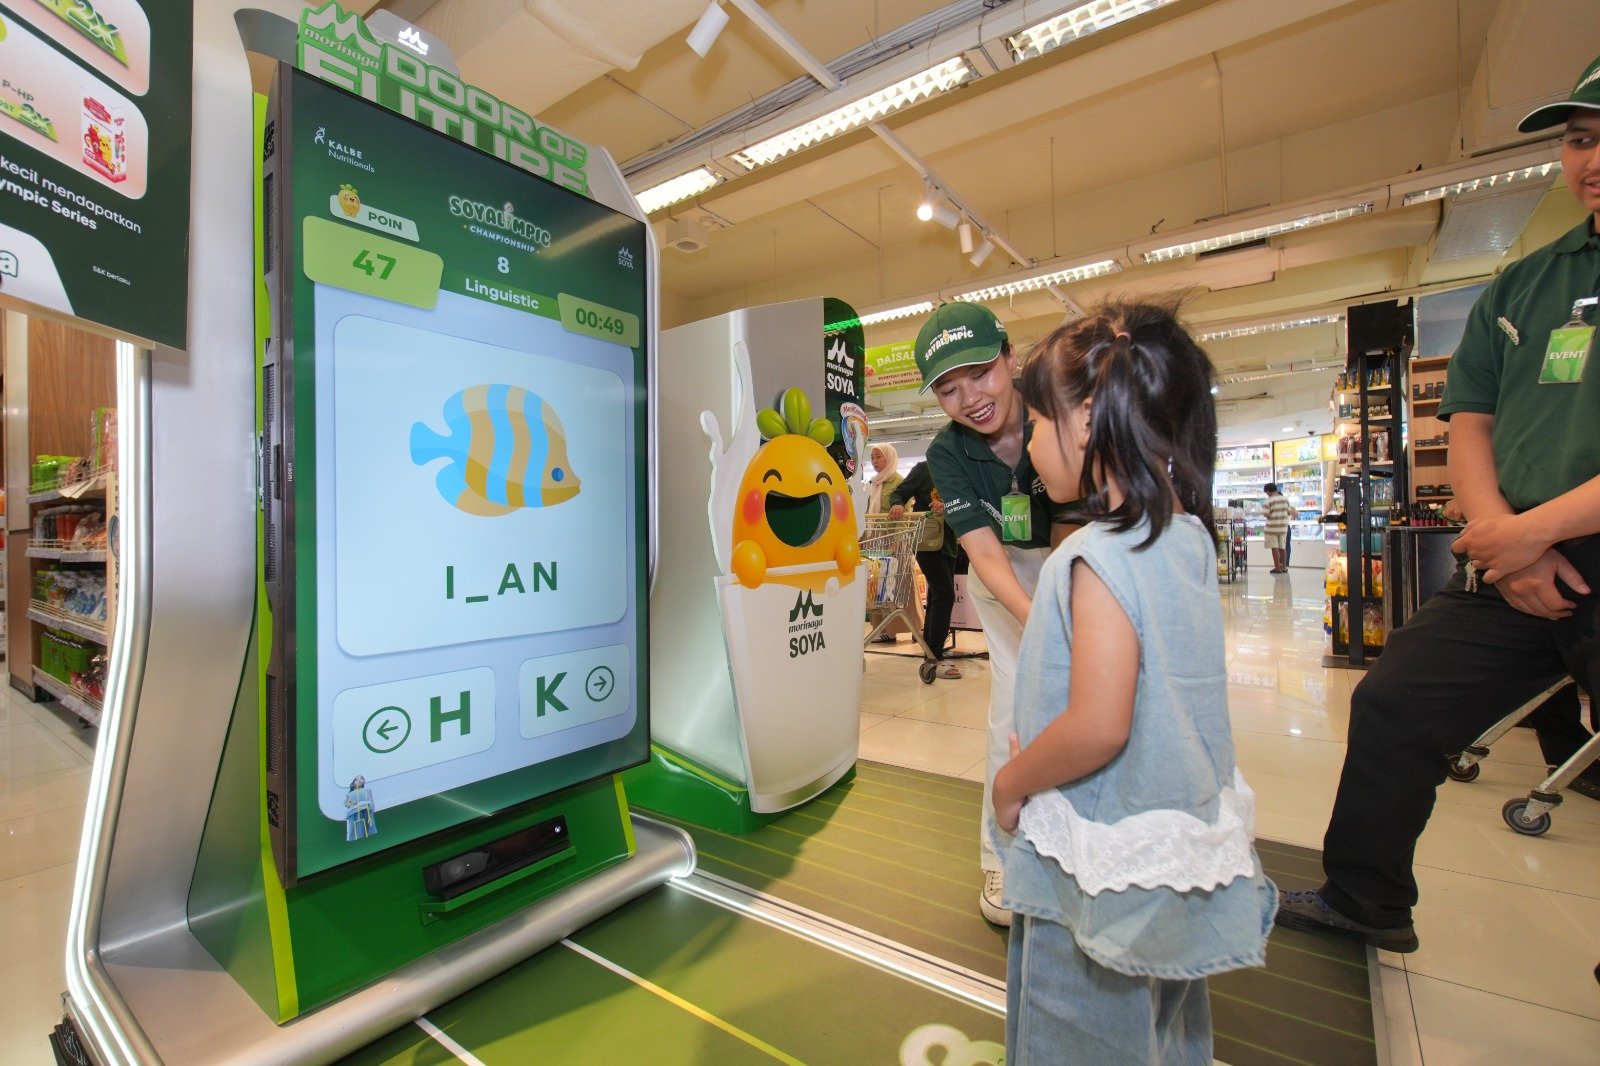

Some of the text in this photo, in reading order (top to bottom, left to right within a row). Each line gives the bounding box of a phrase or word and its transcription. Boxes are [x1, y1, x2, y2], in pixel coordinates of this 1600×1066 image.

[304, 28, 380, 70] morinaga
[387, 44, 587, 163] DOOR OF
[328, 139, 363, 159] KALBE
[328, 149, 375, 173] Nutritionals
[0, 156, 39, 184] kecil
[41, 177, 142, 234] mendapatkan
[51, 200, 97, 230] Series
[368, 211, 403, 231] POIN
[469, 225, 535, 253] CHAMPIONSHIP
[92, 265, 131, 286] S&K berlaku
[352, 250, 397, 281] 47
[497, 256, 510, 274] 8
[465, 277, 540, 309] Linguistic
[575, 307, 625, 336] 00:49
[892, 344, 911, 352] PROMO
[1549, 350, 1585, 360] EVENT
[826, 361, 854, 377] morinaga
[826, 372, 855, 397] SOYA
[1004, 514, 1029, 522] EVENT
[446, 561, 558, 604] I_AN
[788, 618, 823, 634] morinaga
[789, 630, 826, 658] SOYA
[536, 671, 569, 718] K
[429, 690, 471, 744] H
